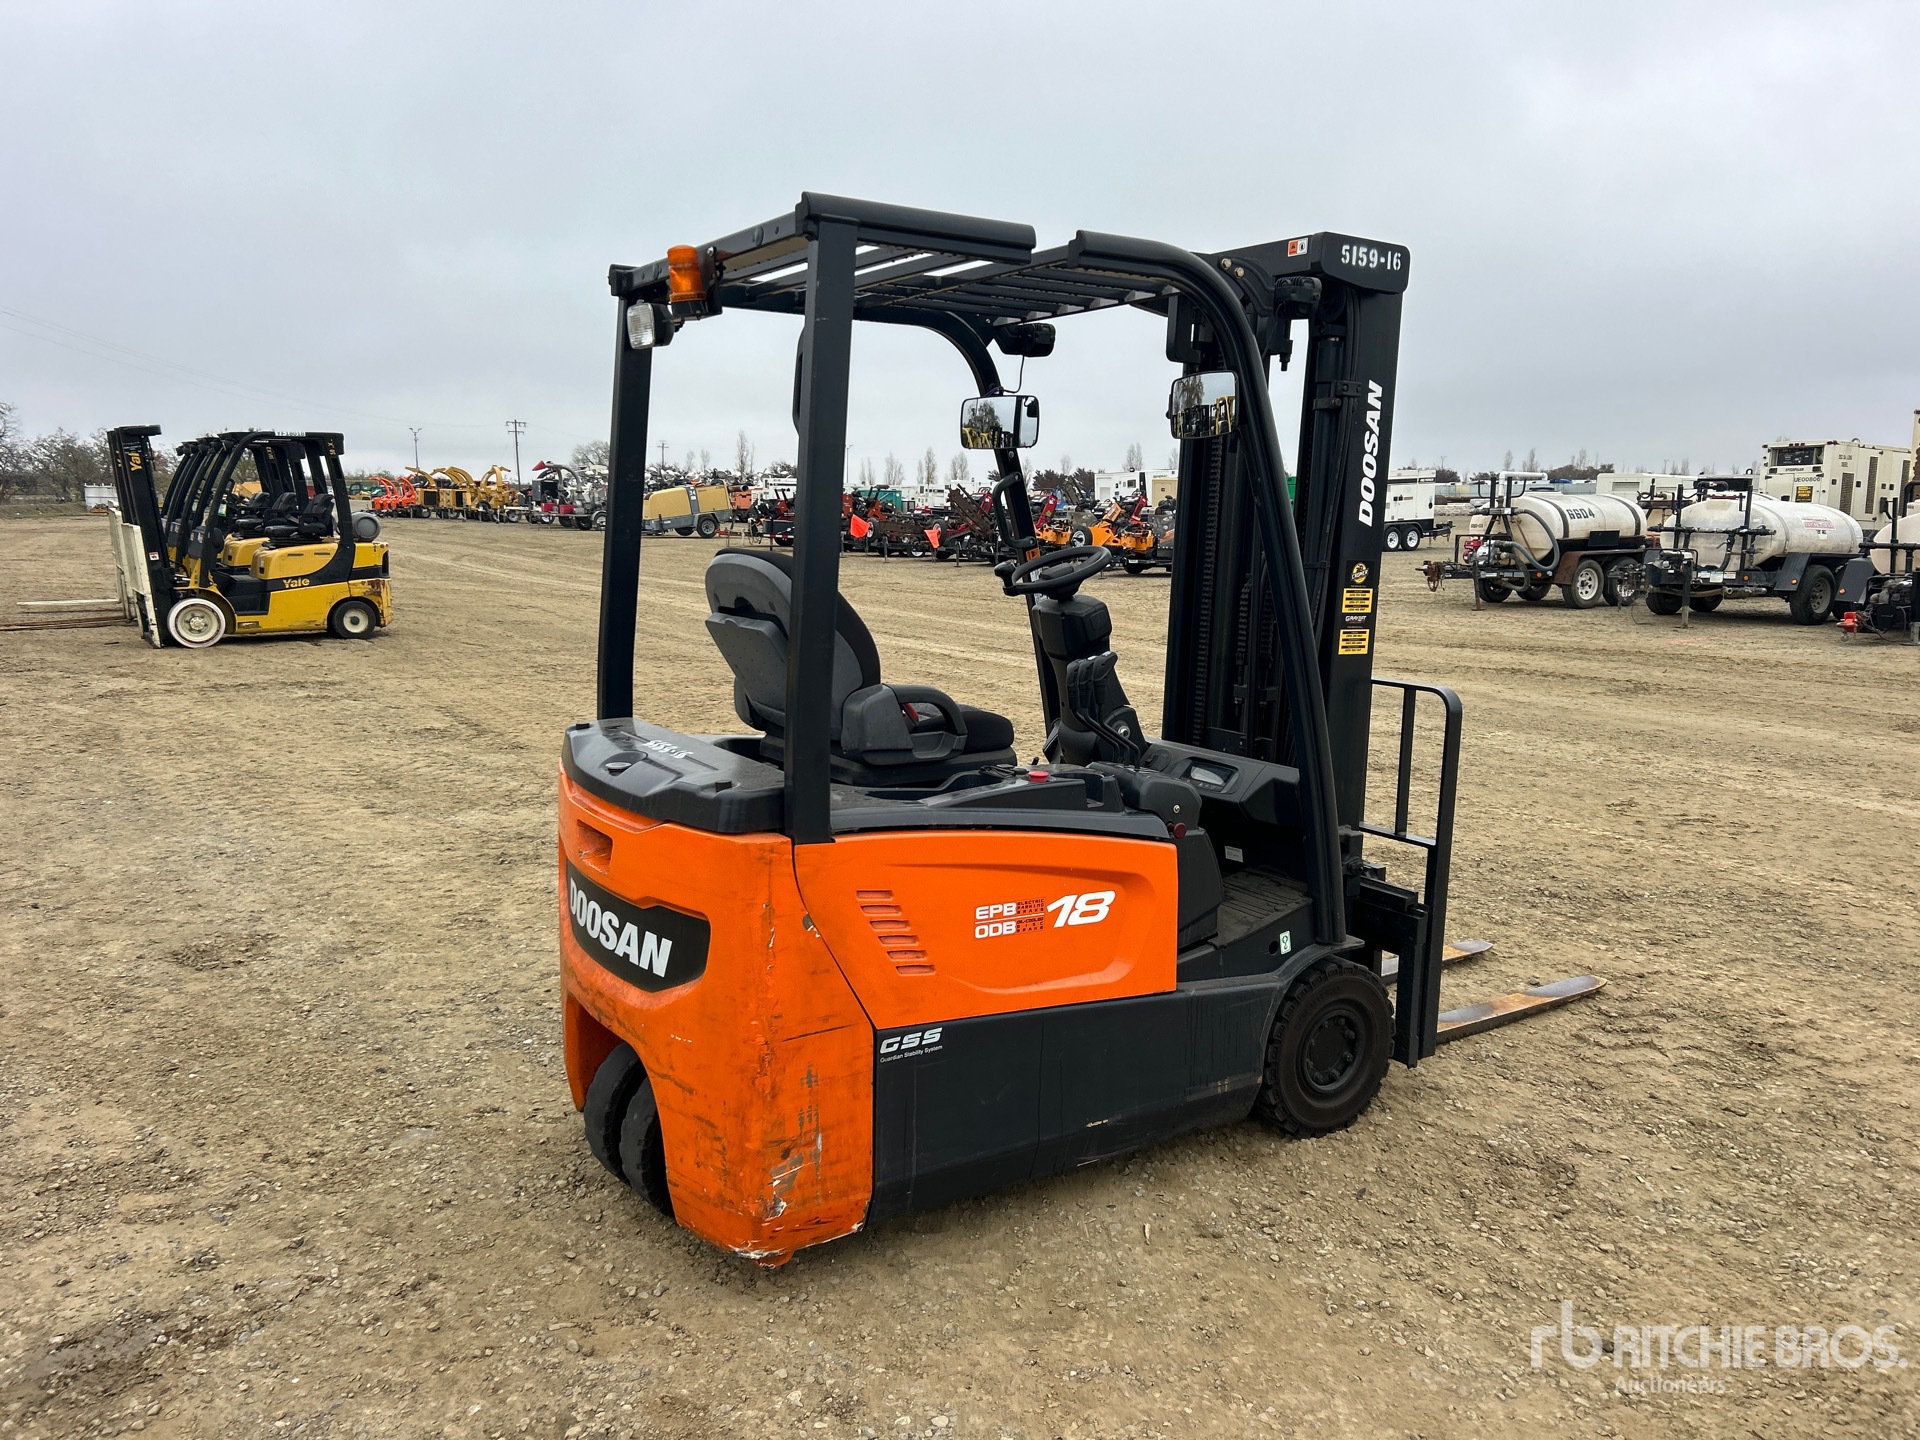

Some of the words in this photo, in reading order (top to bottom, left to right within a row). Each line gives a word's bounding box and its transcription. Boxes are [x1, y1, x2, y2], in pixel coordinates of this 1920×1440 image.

[1358, 379, 1383, 528] DOOSAN
[282, 577, 311, 589] Yale
[975, 902, 1017, 919] EPB
[1017, 898, 1044, 906] ELECTRIC
[1046, 890, 1116, 928] 18
[569, 877, 673, 978] DOOSAN
[975, 921, 1016, 938] ODB
[880, 1027, 943, 1054] GSS
[880, 1053, 904, 1063] Guardian
[904, 1049, 924, 1058] Stability
[924, 1045, 943, 1053] System
